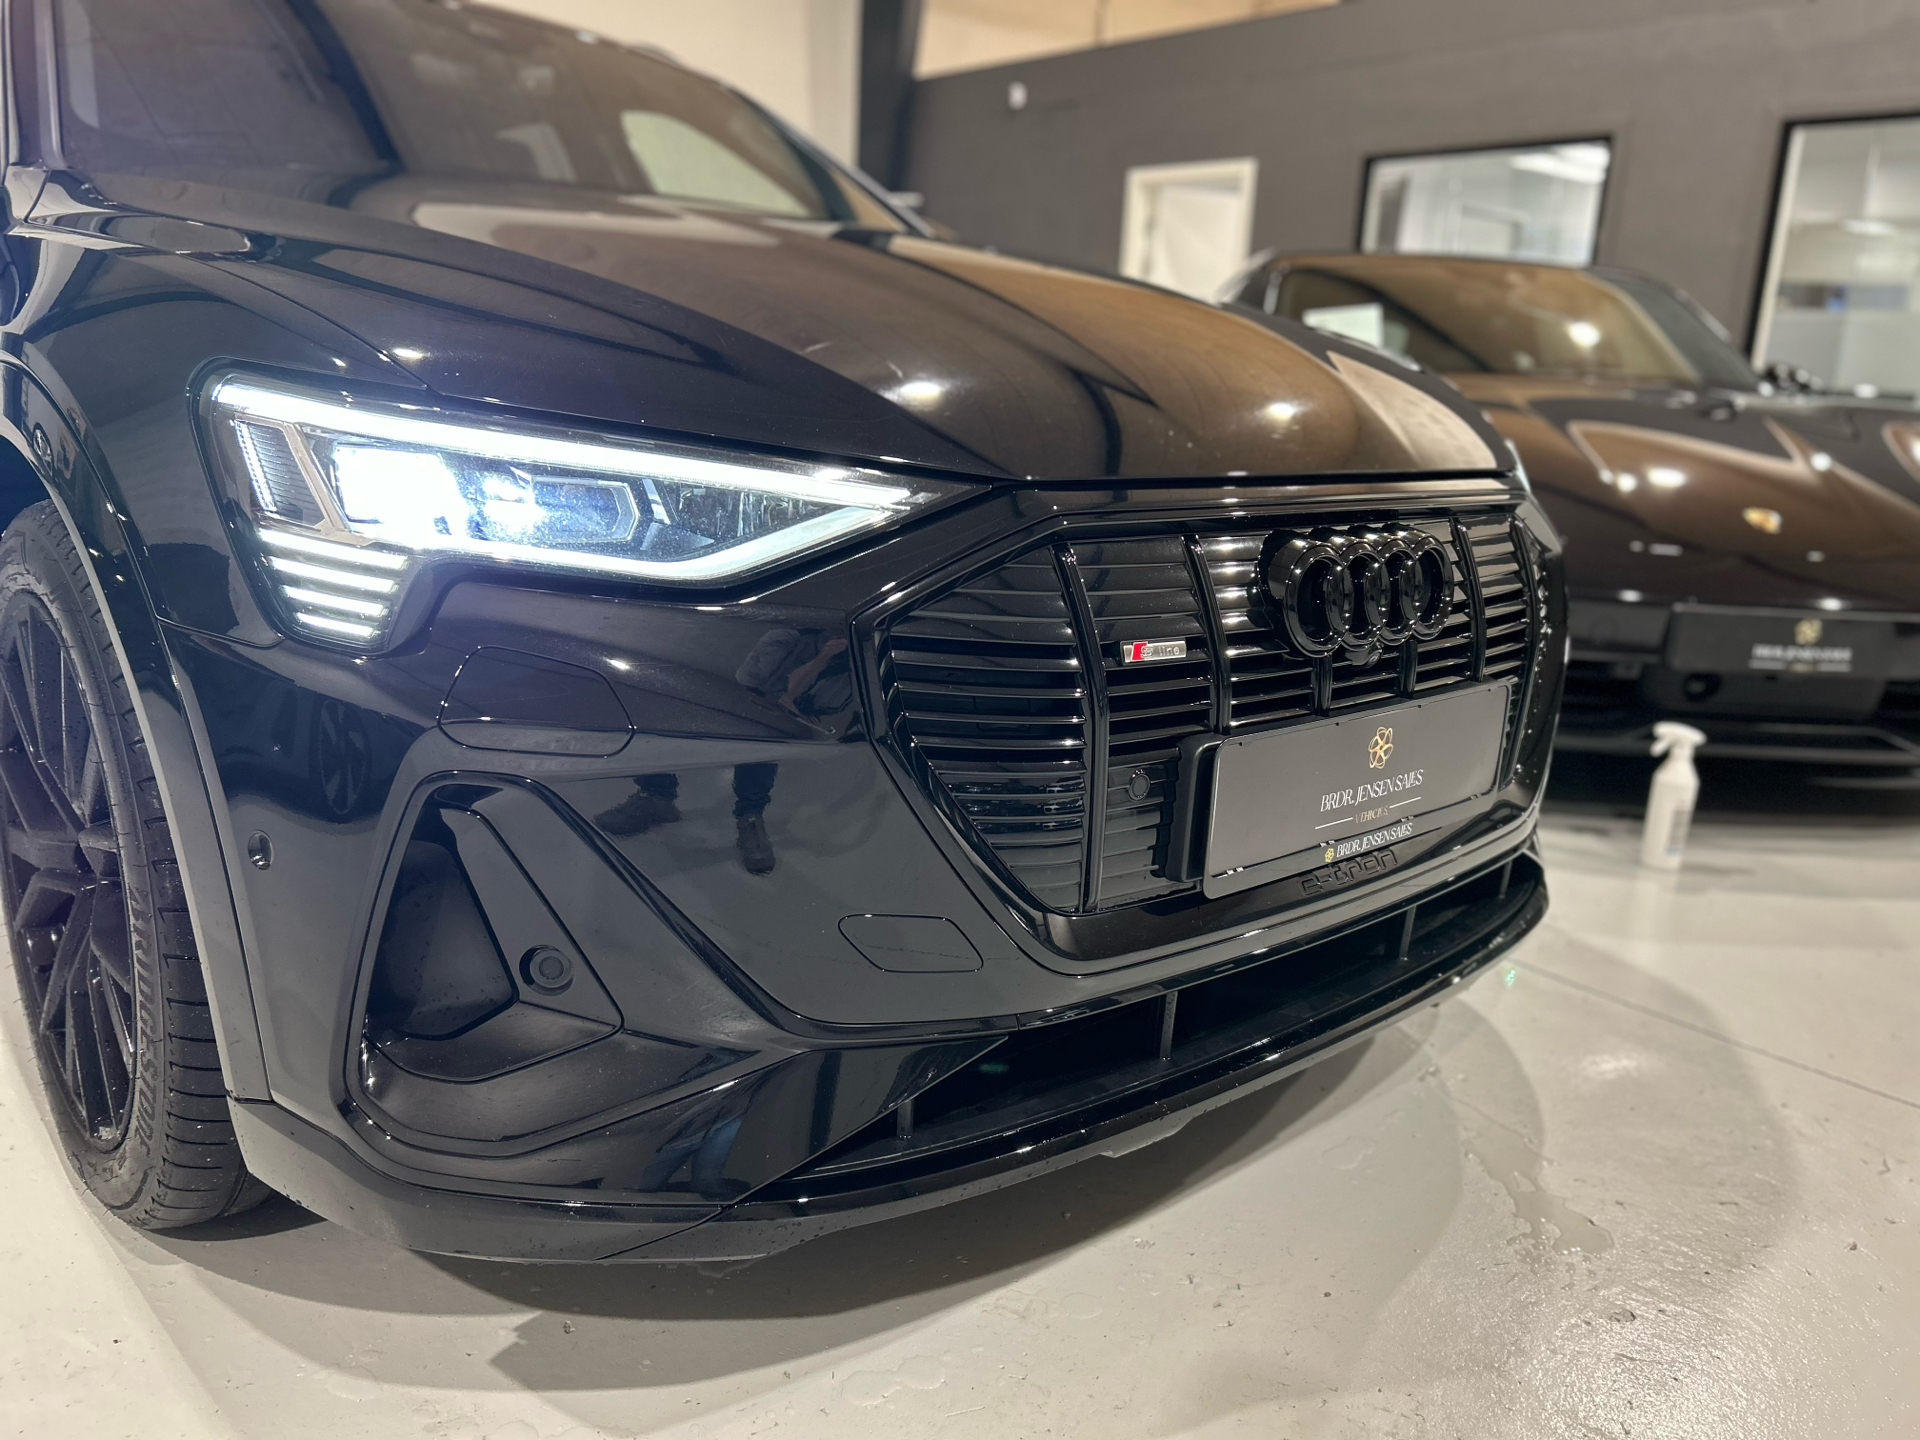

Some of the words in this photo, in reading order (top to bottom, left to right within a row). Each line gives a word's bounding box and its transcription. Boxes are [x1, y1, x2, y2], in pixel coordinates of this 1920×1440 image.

[1158, 645, 1180, 657] line
[1320, 789, 1355, 812] BRDR.
[1355, 777, 1395, 806] JENSEN
[1394, 769, 1424, 792] SALES
[1336, 840, 1361, 857] BRDR.
[1360, 831, 1391, 852] JENSEN
[1390, 823, 1413, 840] SALES
[1300, 848, 1398, 896] e-tron
[128, 881, 158, 1158] BRIDGESTONE
